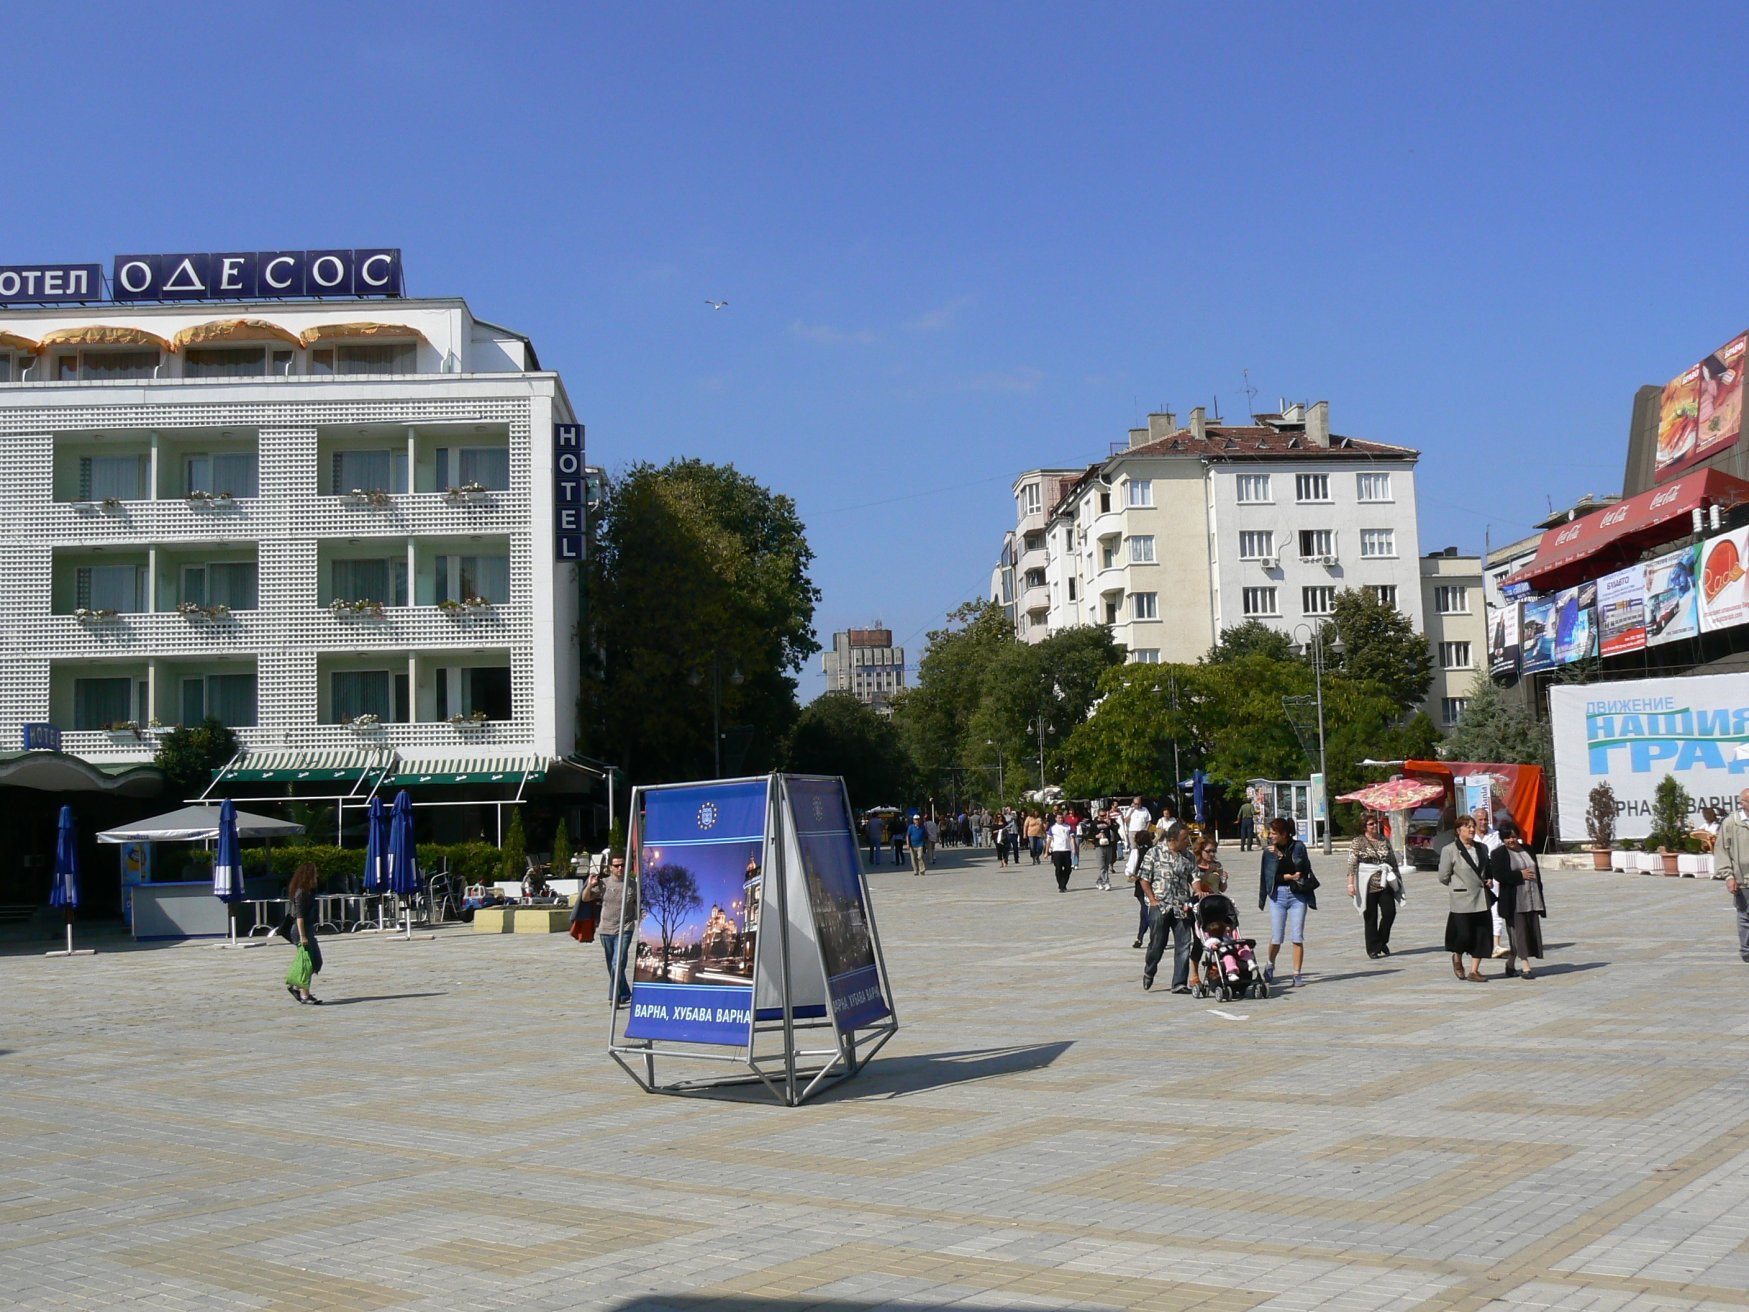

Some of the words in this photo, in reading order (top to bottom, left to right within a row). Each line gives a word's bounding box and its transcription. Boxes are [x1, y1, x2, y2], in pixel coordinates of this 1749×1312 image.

[119, 253, 393, 297] ОДЕСОС
[558, 424, 580, 559] HOTEL
[1586, 696, 1675, 714] ДВИЖЕНИЕ
[29, 727, 61, 749] HOTEL
[634, 1003, 669, 1021] ВАРНА,
[672, 1006, 712, 1023] ХУБАВА
[715, 1008, 751, 1024] ВАРНА
